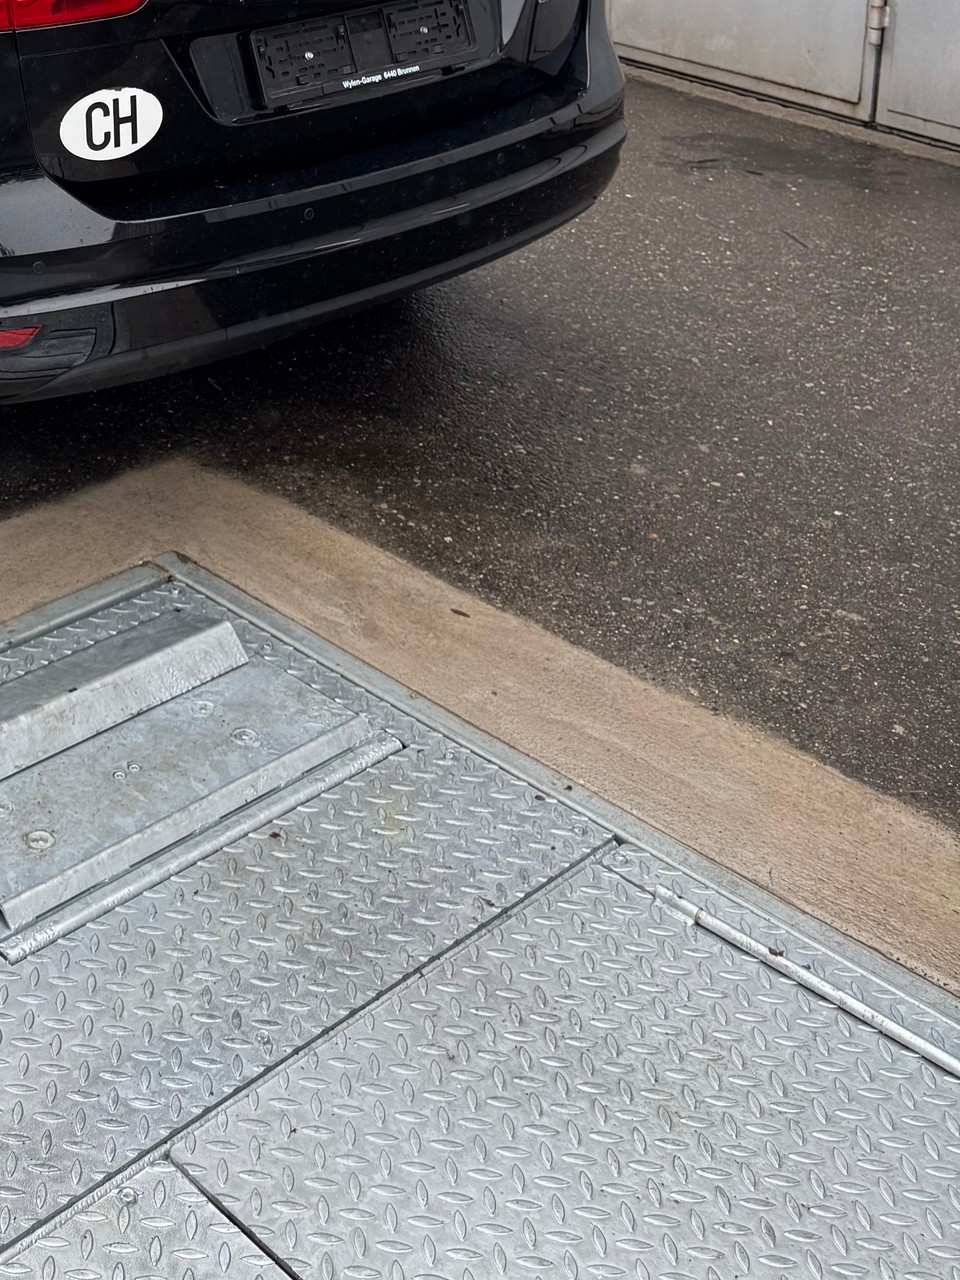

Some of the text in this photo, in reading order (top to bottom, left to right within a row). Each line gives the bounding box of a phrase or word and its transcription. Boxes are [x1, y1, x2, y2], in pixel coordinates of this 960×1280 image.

[383, 69, 398, 79] 6440
[397, 65, 420, 76] Brunnen
[85, 94, 138, 151] CH
